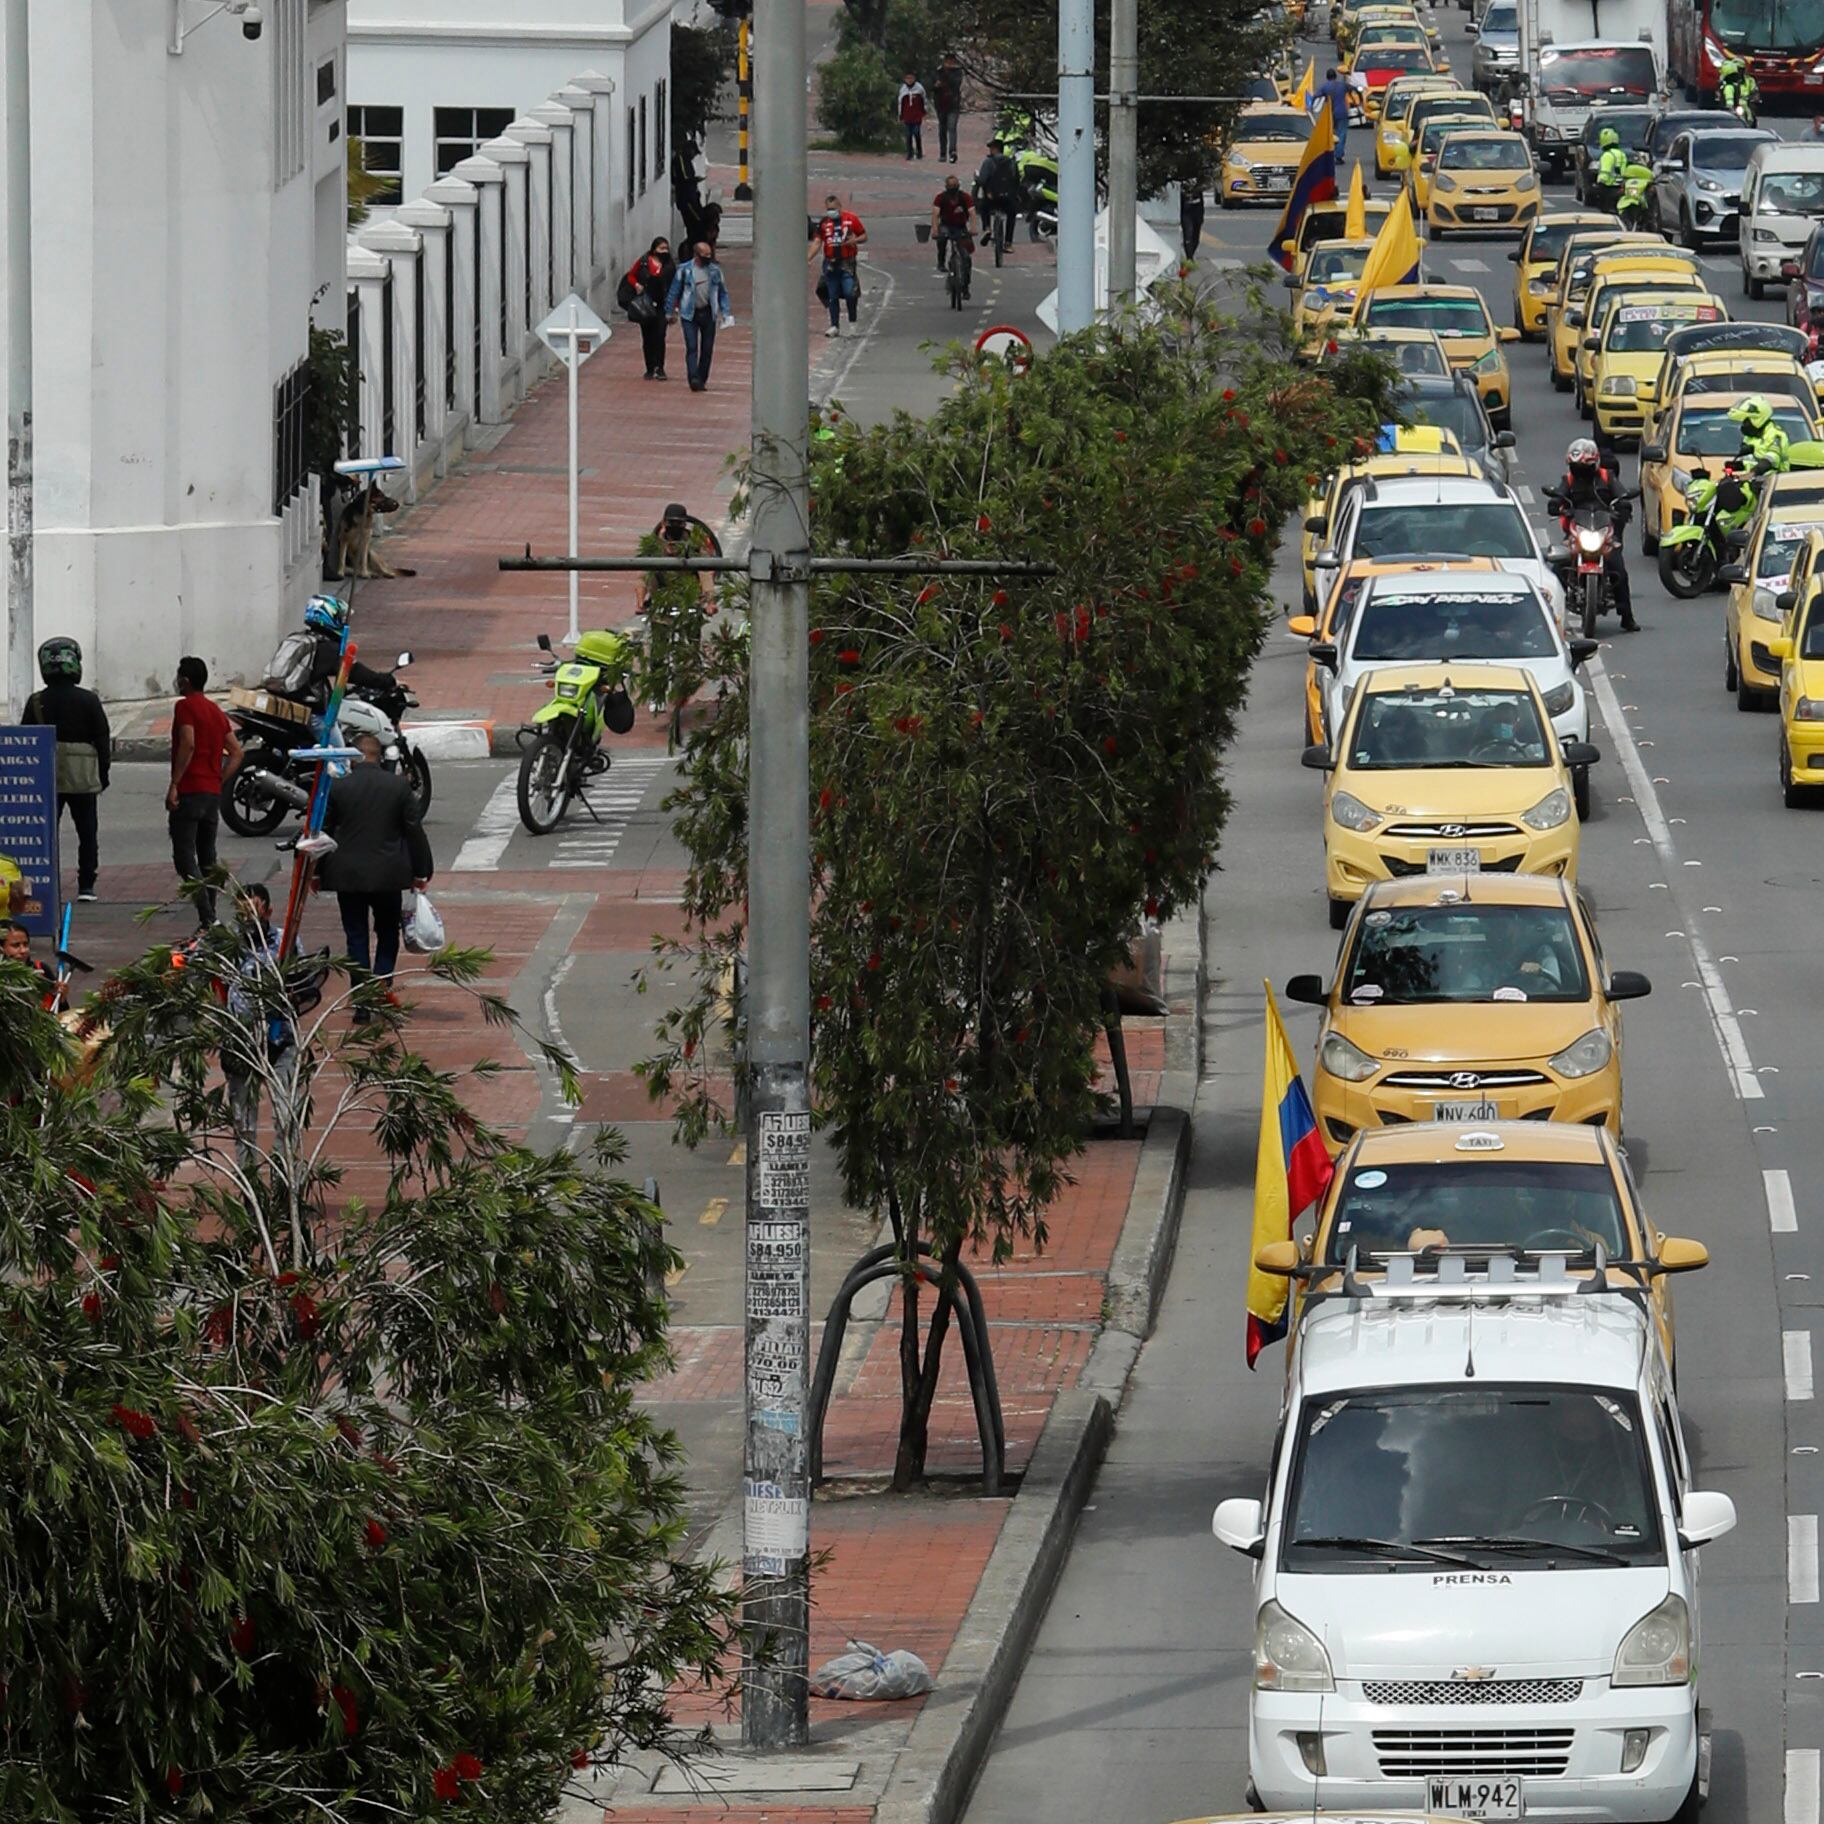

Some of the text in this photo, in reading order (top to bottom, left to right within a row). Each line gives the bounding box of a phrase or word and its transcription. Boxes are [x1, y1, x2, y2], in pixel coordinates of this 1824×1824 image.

[1433, 1574, 1512, 1585] PRENSA
[1431, 1783, 1518, 1809] WLM 942
